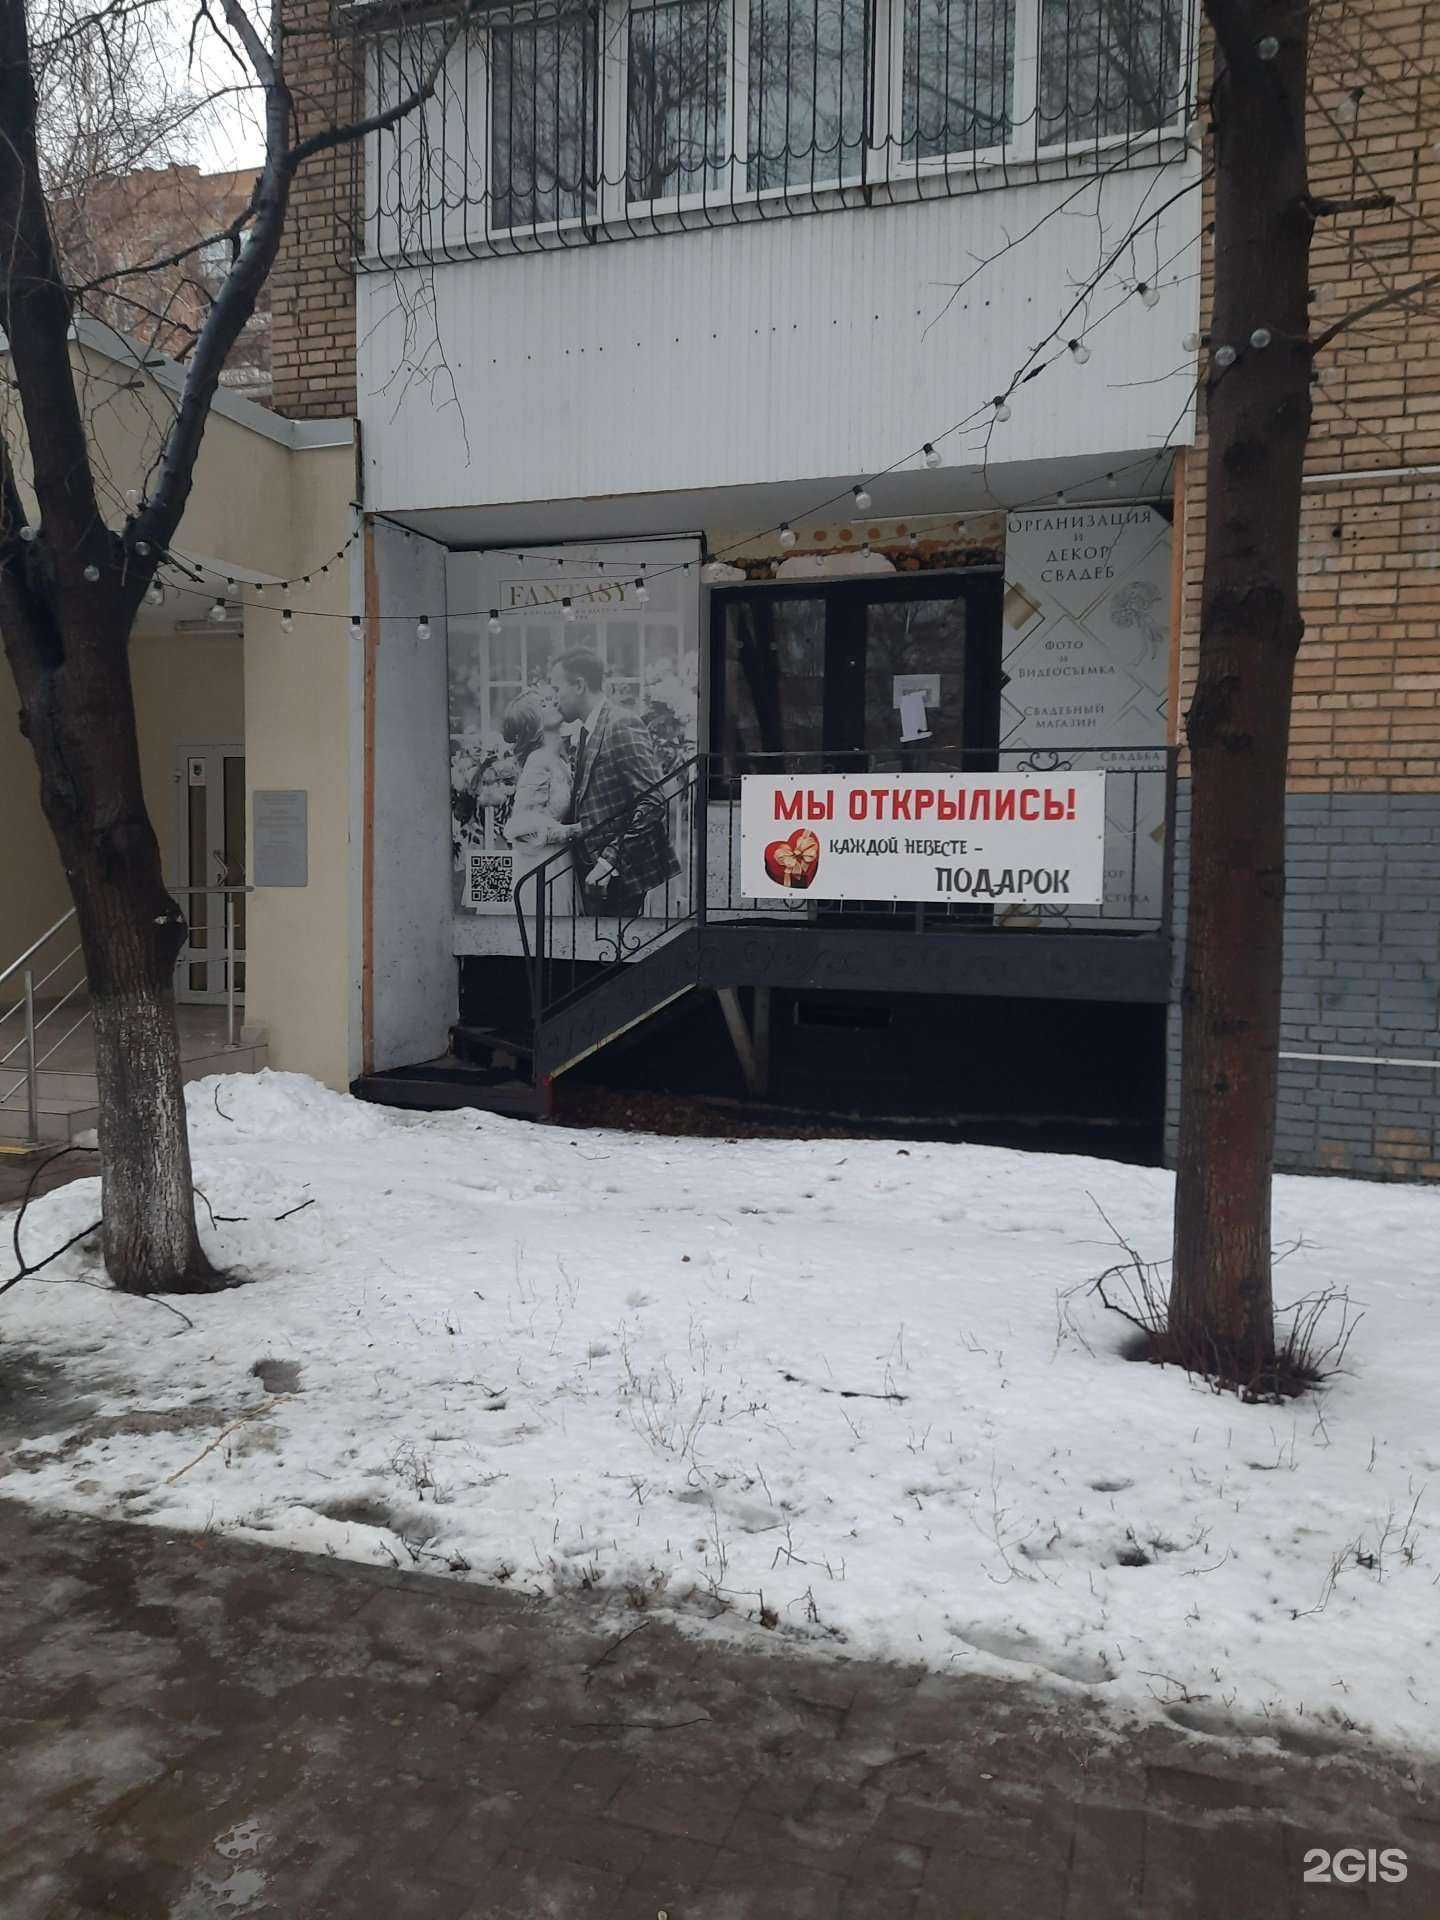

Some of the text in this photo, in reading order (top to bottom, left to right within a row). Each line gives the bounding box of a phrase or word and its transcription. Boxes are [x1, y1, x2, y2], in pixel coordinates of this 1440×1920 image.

[1008, 511, 1151, 533] ОРГАНИЗАЦИЯ
[1073, 533, 1084, 542] И
[1046, 546, 1111, 562] ДЕКОР
[1041, 566, 1115, 583] СВАДЕБ
[510, 581, 629, 606] FANTASY
[1044, 641, 1084, 650] ФОТО
[1023, 703, 1105, 716] СВАДЕБНЫЙ
[1036, 719, 1096, 729] МАГАЗИН
[773, 788, 1076, 821] МЫ ОТКРЫЛИСЬ!
[829, 836, 898, 856] КАЖДОЙ
[904, 837, 968, 856] НЕВЕСТЕ
[935, 866, 1071, 898] ПОДАРОК
